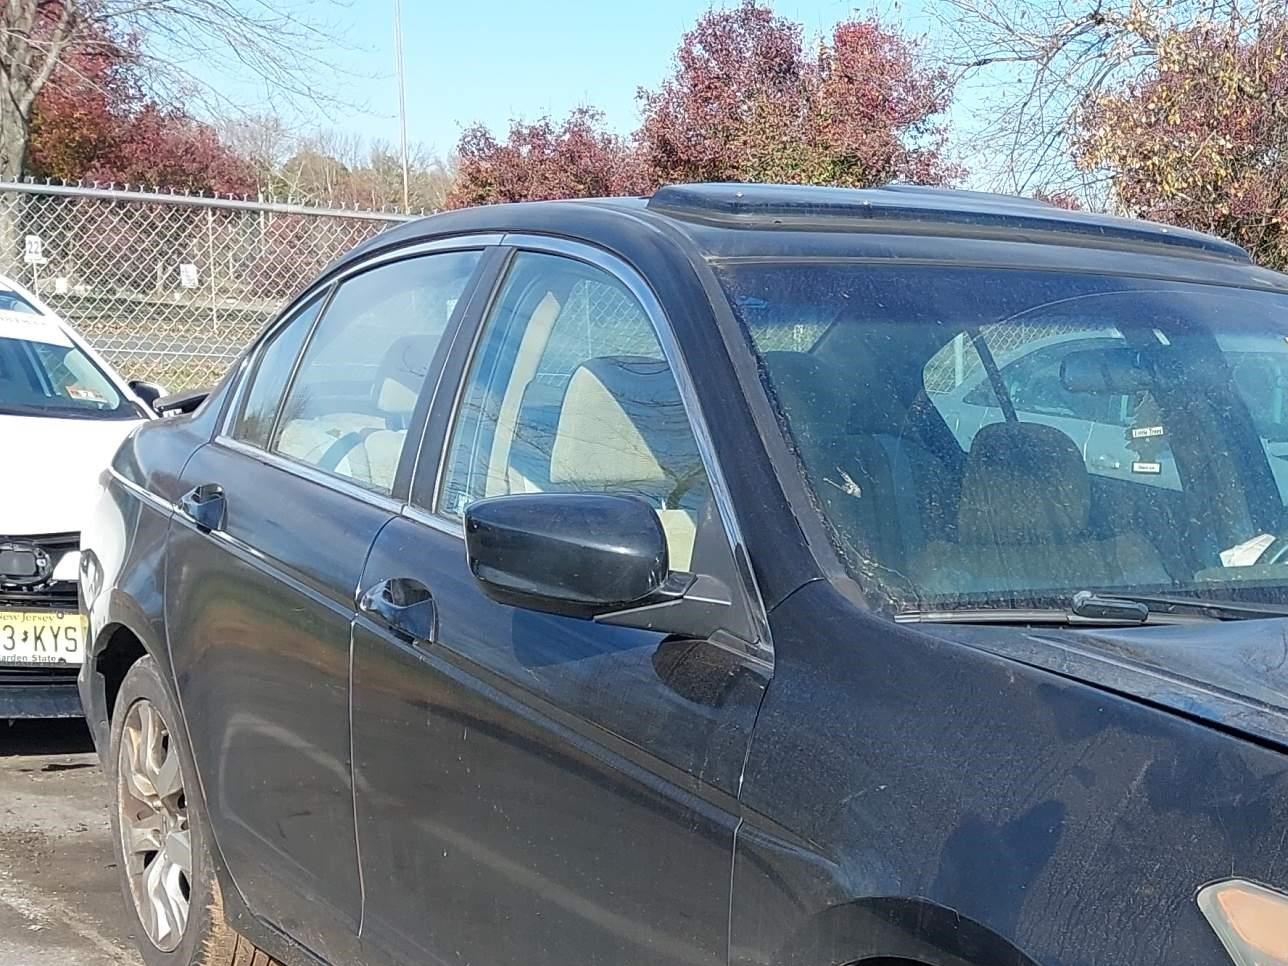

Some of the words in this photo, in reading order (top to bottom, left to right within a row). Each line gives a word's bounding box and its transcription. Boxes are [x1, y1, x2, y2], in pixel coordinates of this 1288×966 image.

[20, 612, 55, 622] Jersey
[0, 654, 28, 662] arden
[31, 655, 57, 663] State
